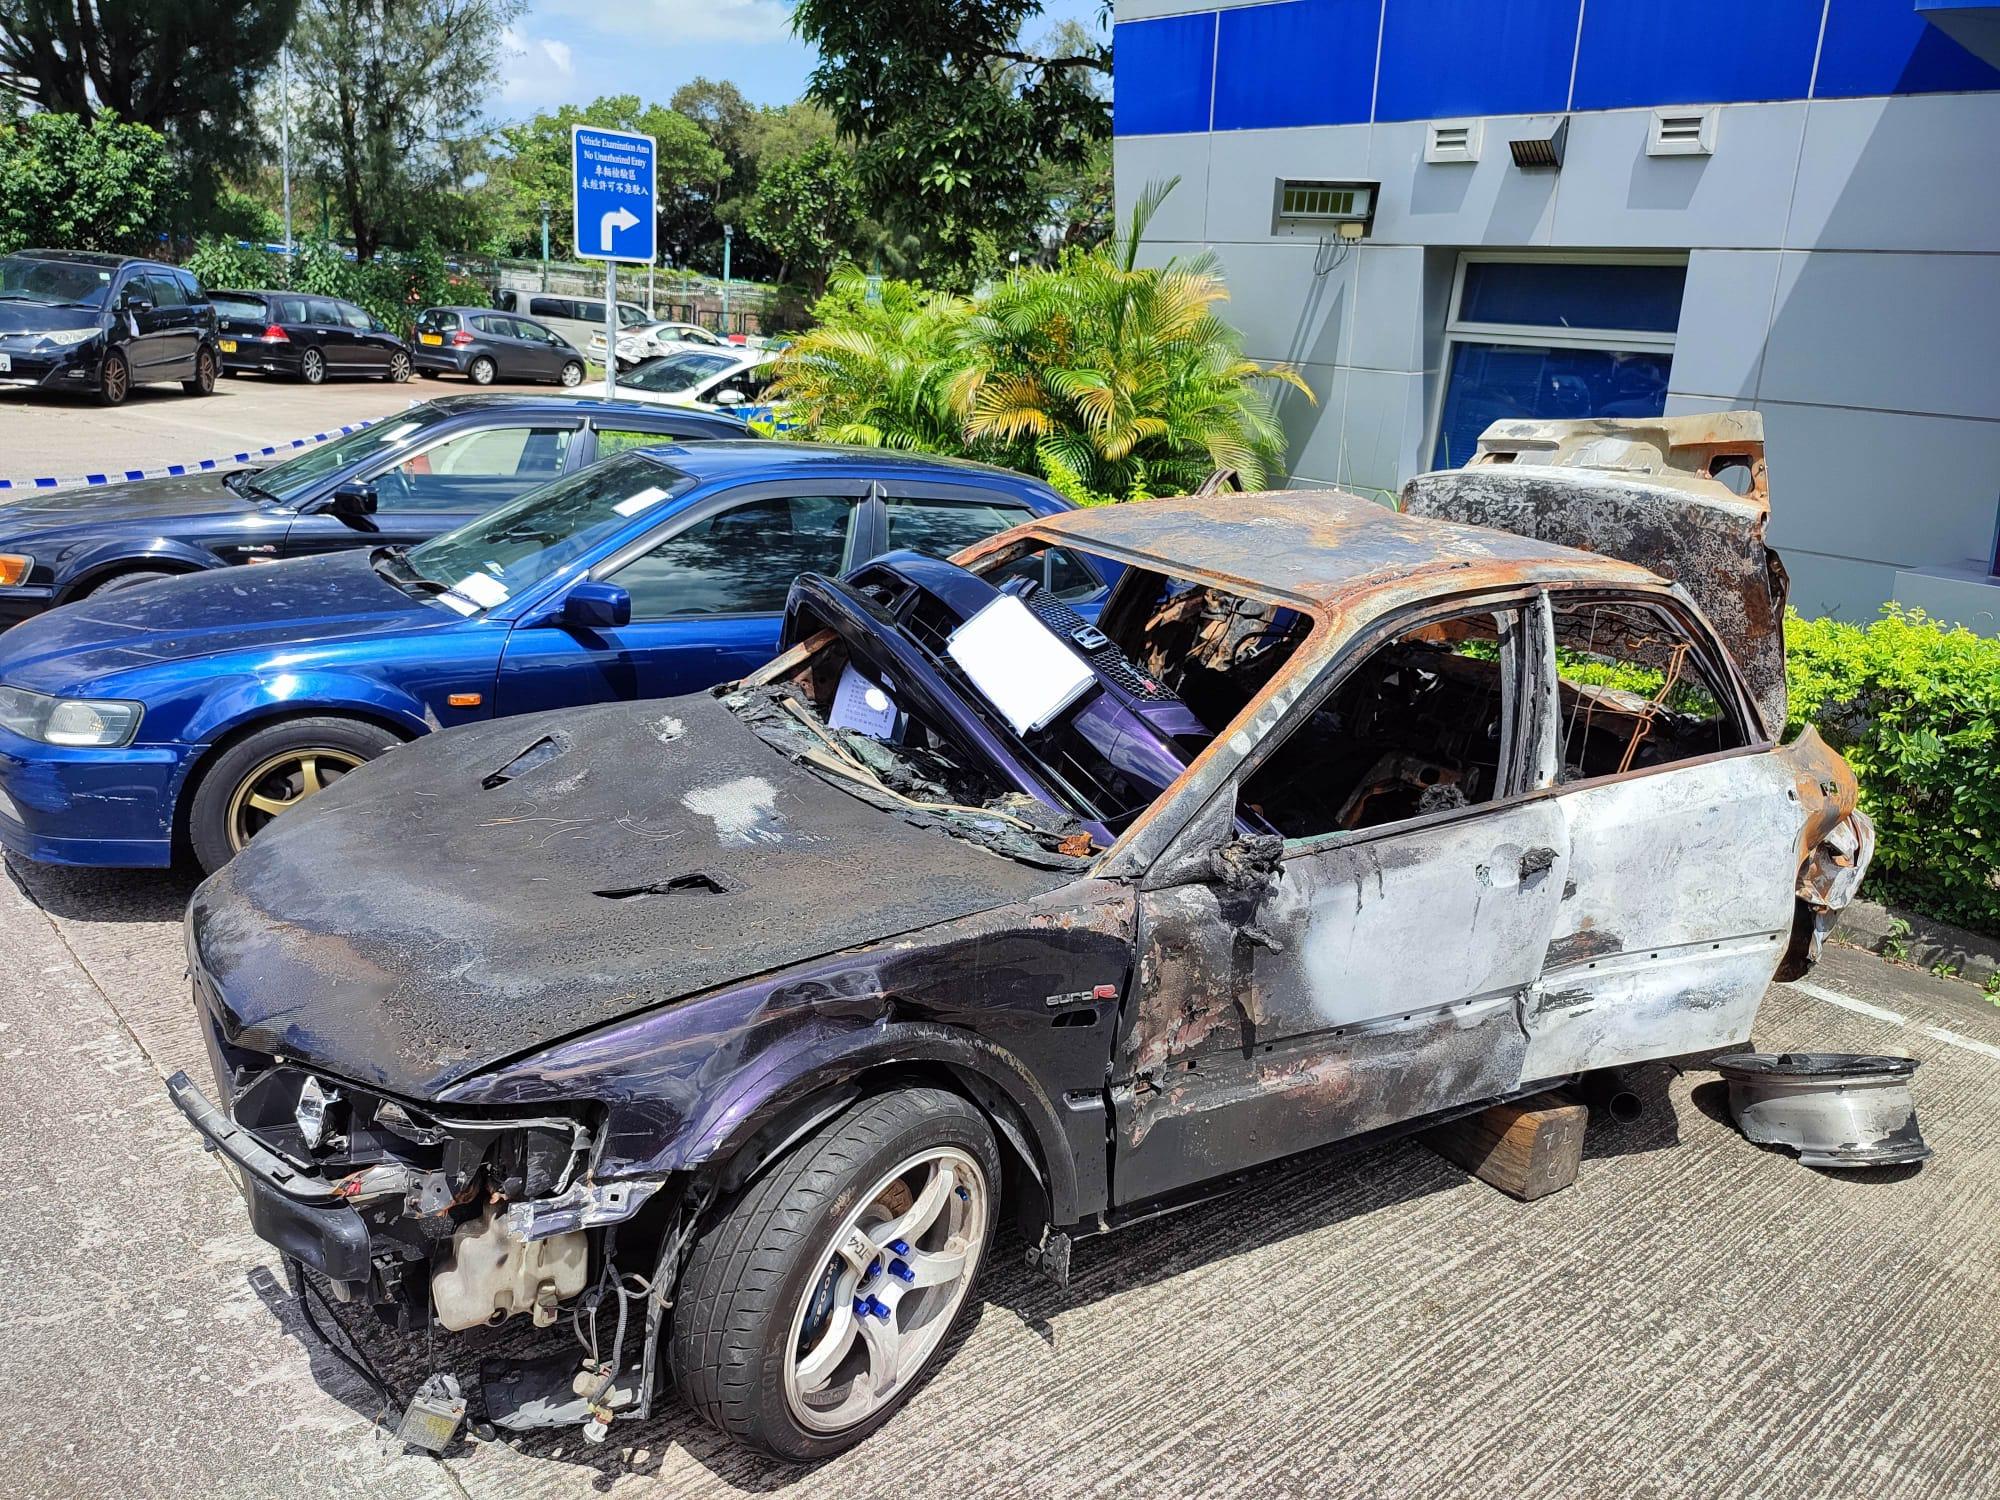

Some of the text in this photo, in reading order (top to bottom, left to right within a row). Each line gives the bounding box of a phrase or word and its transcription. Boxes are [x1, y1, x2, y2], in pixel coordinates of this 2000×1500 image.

[580, 135, 650, 154] Vehicle Examination Area
[584, 150, 593, 160] No
[631, 156, 647, 169] Entry
